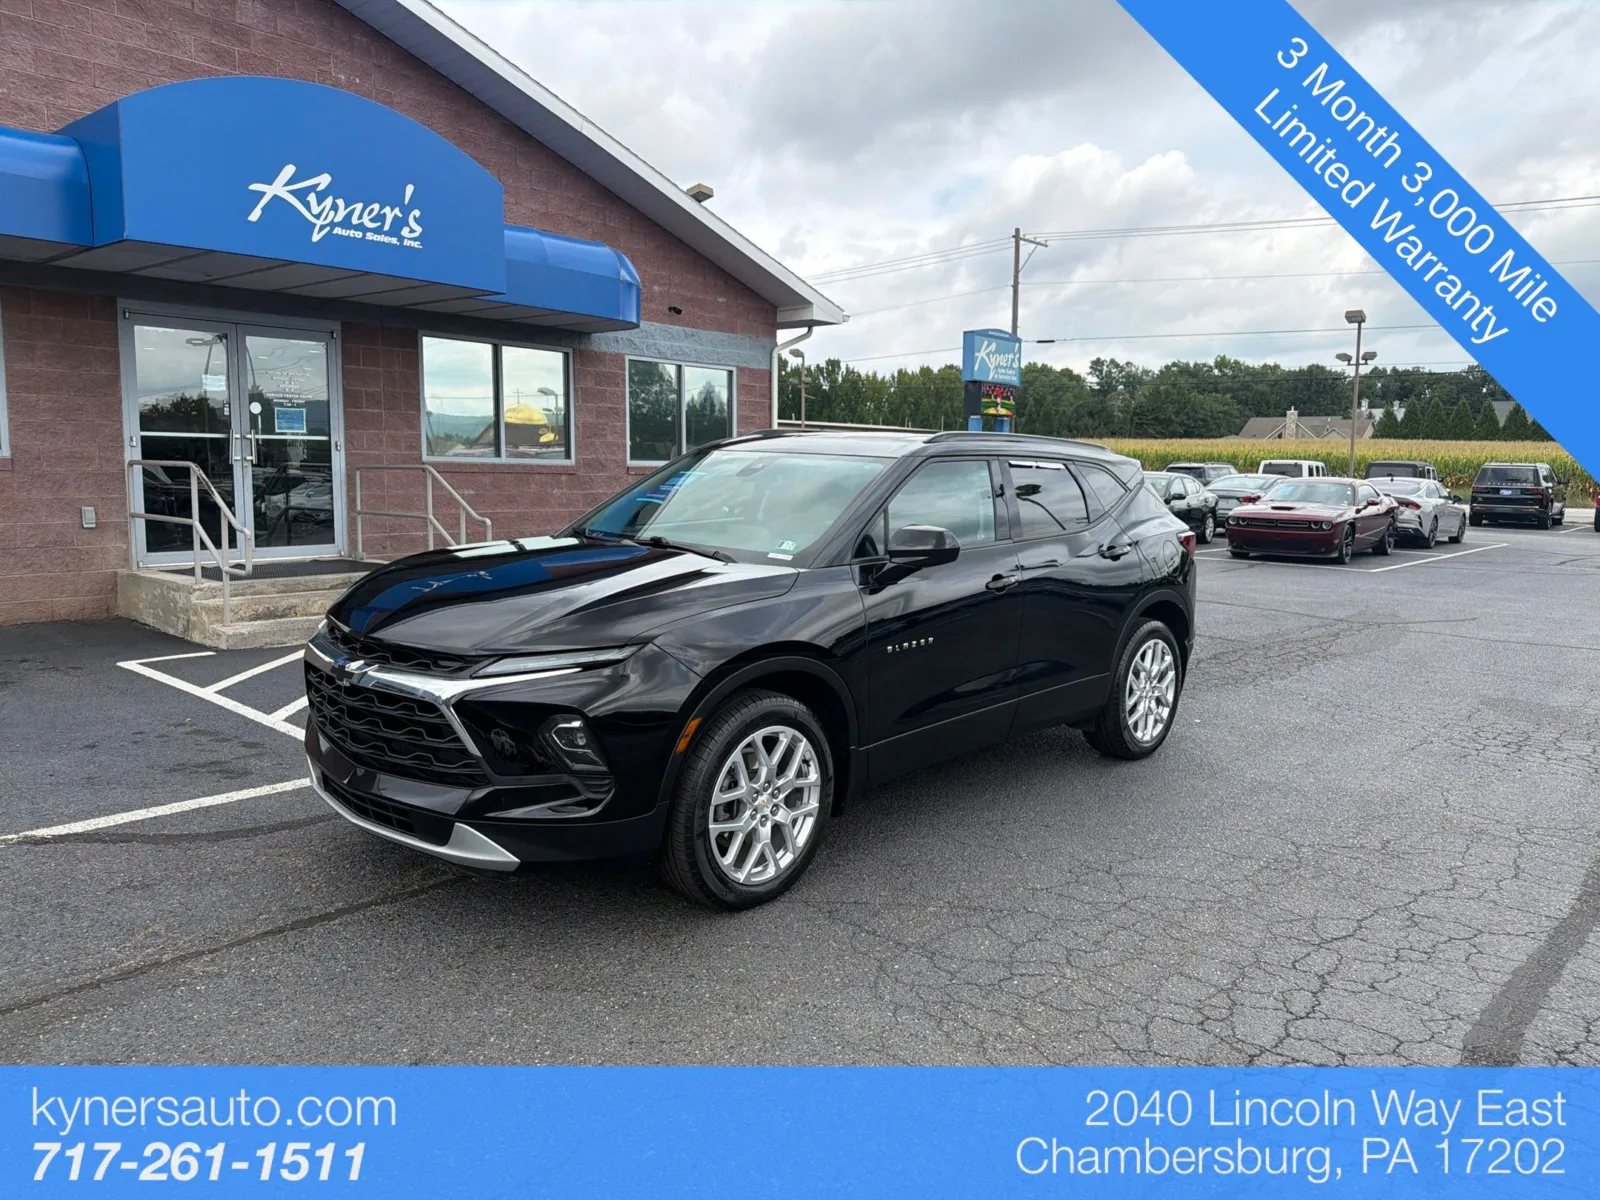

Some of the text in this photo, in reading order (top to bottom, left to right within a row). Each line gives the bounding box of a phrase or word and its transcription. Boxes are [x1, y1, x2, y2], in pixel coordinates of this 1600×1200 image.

[247, 163, 423, 243] Kyner's
[332, 226, 423, 249] Auto Sales, Inc.
[974, 340, 1019, 380] Kyner's
[887, 637, 934, 653] BLAZER
